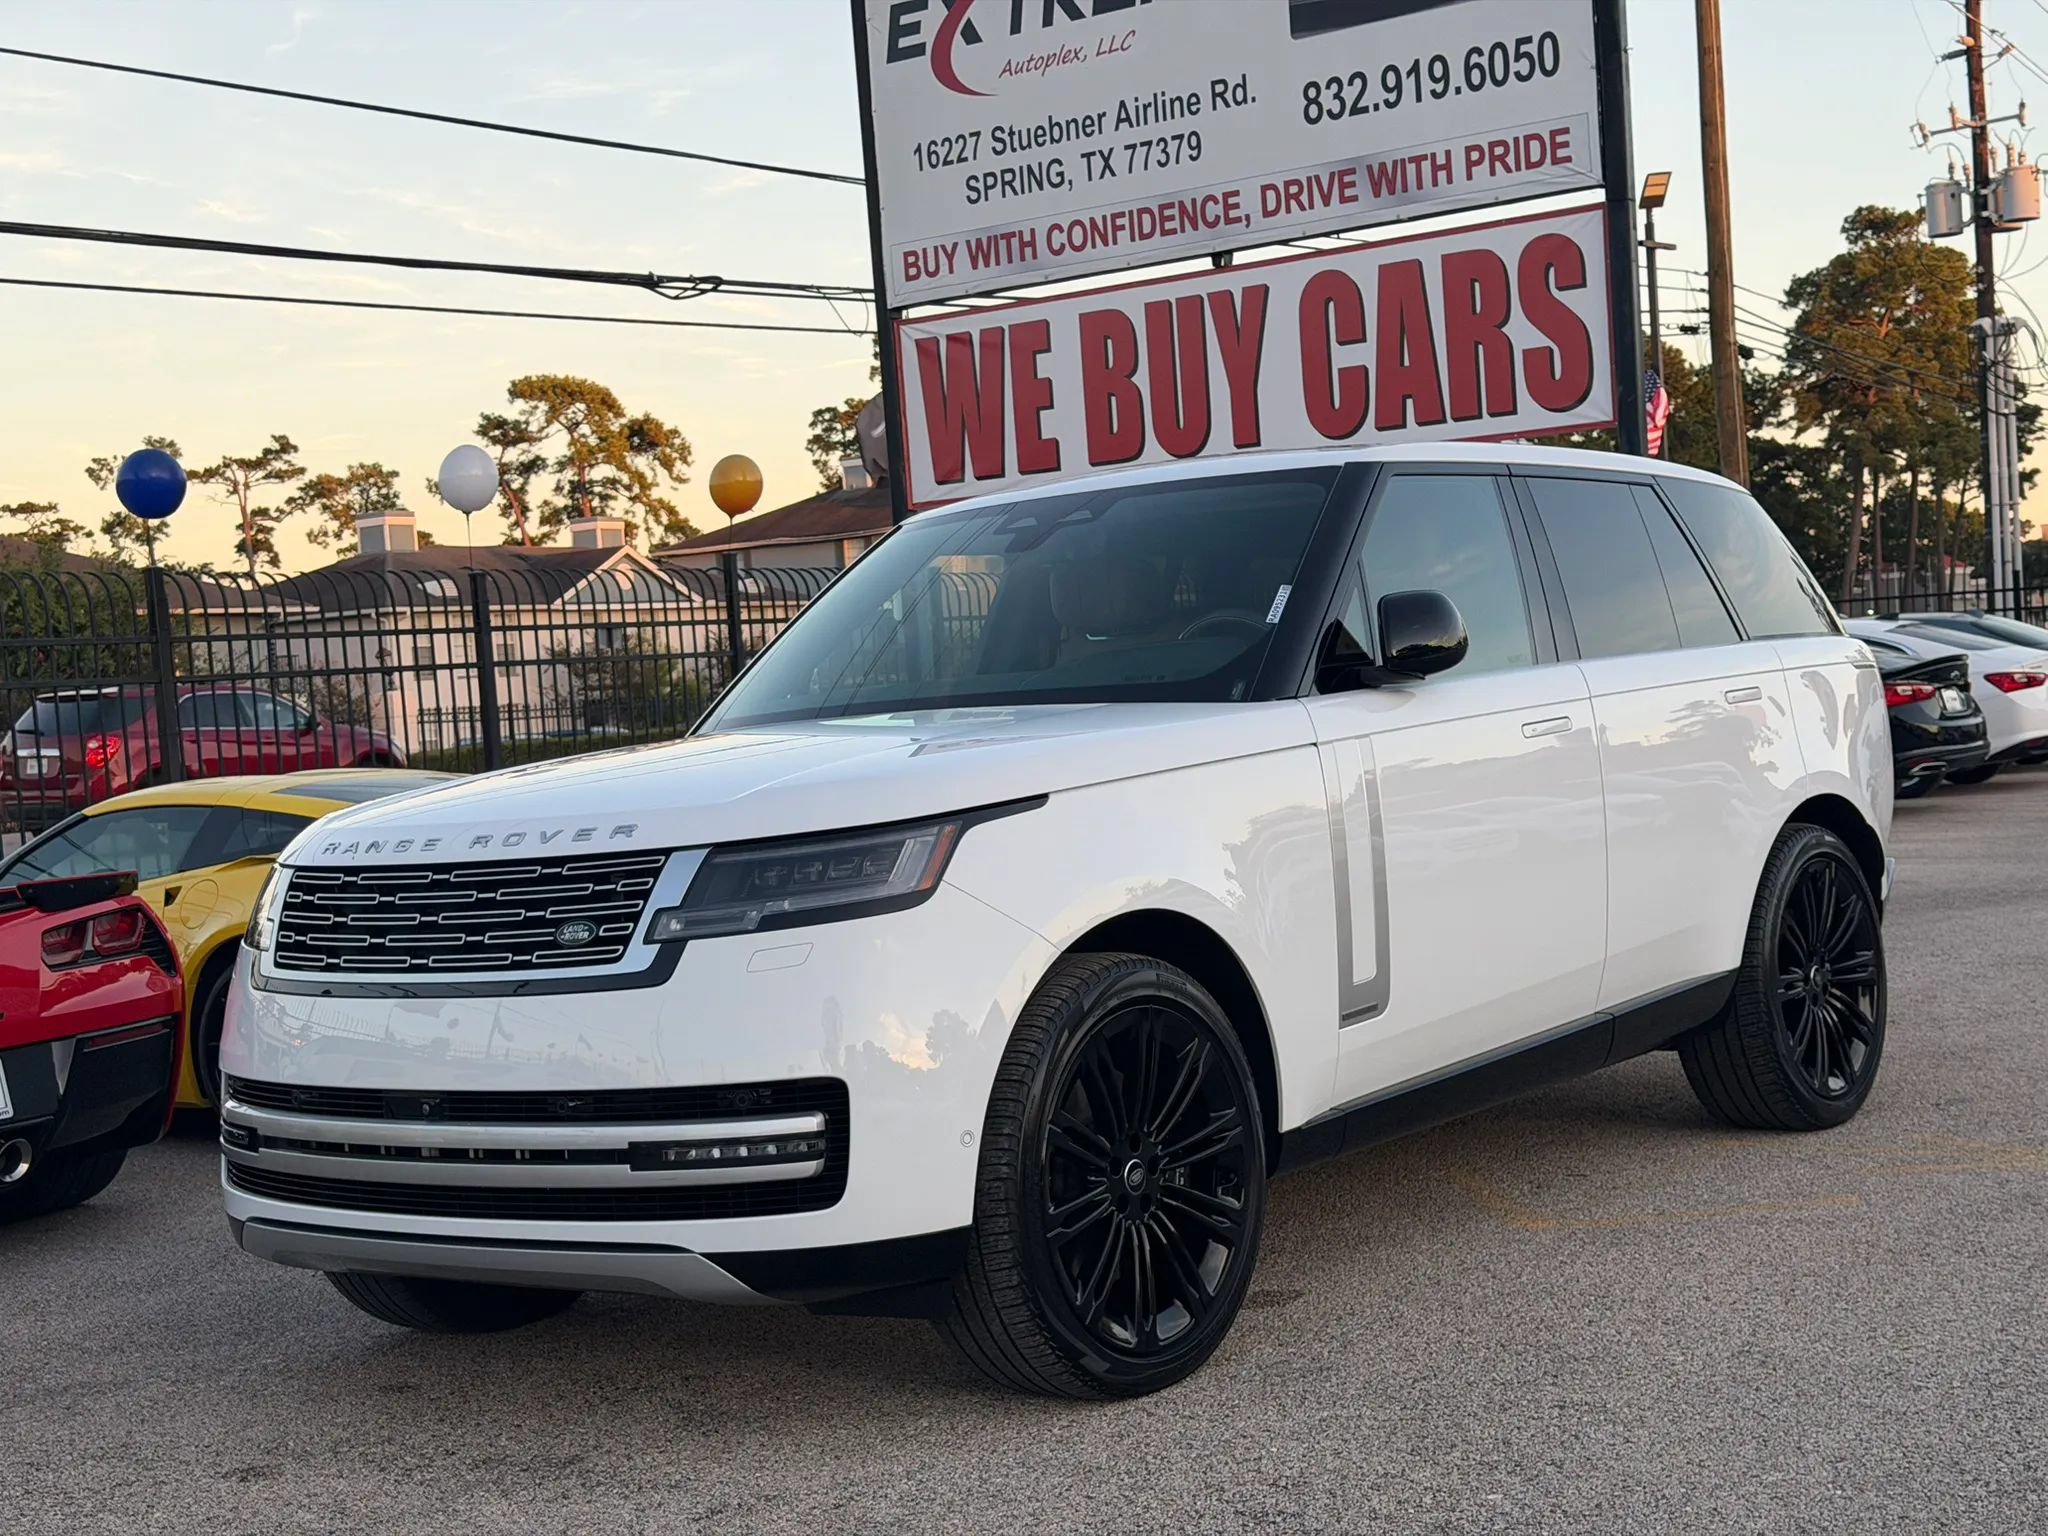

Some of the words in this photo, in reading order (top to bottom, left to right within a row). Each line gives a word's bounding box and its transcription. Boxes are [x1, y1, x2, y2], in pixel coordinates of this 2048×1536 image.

[998, 44, 1088, 79] Autoplex,
[1095, 29, 1137, 57] LLC
[1302, 31, 1561, 125] 832.919.6050
[913, 131, 983, 172] 16227
[990, 110, 1108, 156] Stuebner
[1114, 91, 1202, 132] Airline
[1210, 73, 1258, 111] Rd.
[903, 241, 960, 283] BUY
[965, 228, 1038, 270] WITH
[1046, 189, 1252, 256] CONFIDENCE,
[1260, 167, 1360, 220] DRIVE
[1365, 149, 1454, 199] WITH
[1464, 126, 1573, 182] PRIDE
[965, 157, 1074, 205] SPRING,
[1081, 147, 1118, 182] TX
[1123, 130, 1203, 175] 77379
[915, 318, 1061, 485] WE
[1078, 284, 1270, 467] BUY
[1299, 233, 1593, 440] CARS
[321, 837, 444, 857] RANGE
[468, 823, 639, 850] ROVER
[563, 924, 584, 934] LAND
[563, 931, 590, 941] ROVER
